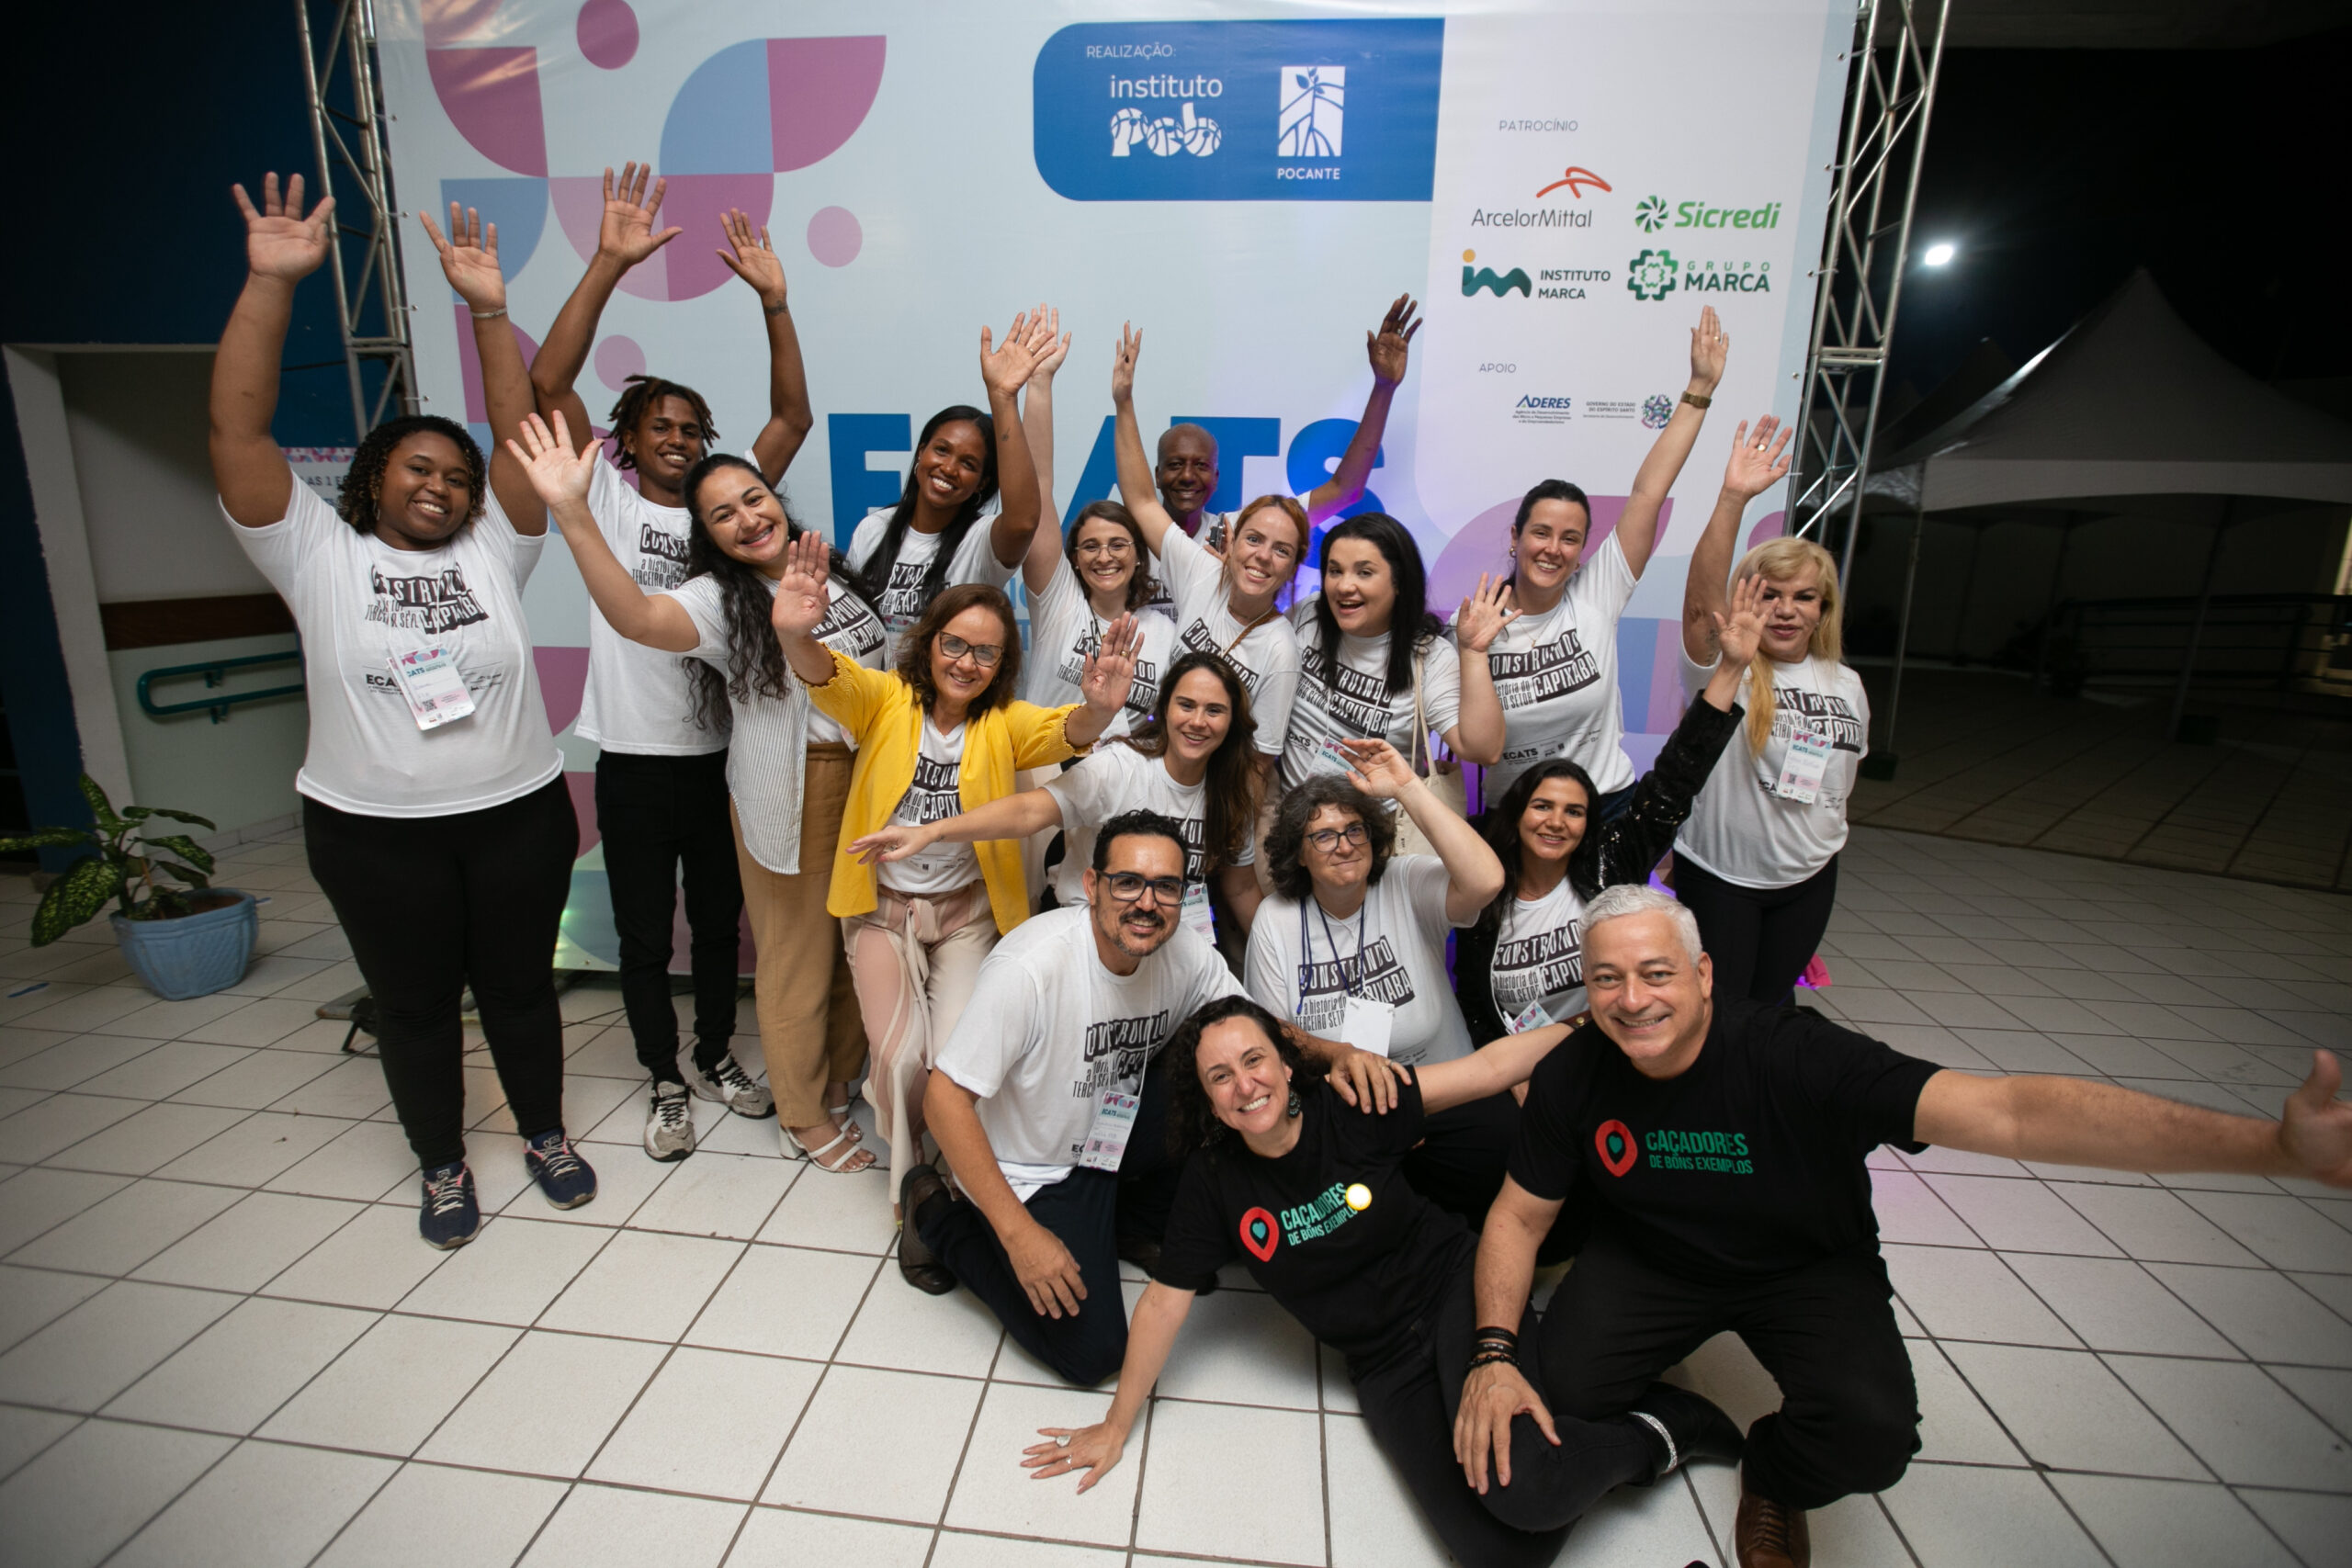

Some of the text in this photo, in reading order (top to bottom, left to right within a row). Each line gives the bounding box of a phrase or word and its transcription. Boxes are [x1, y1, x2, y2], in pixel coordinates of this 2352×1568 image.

[1086, 41, 1177, 61] REALIZAÇÃO:
[1110, 74, 1224, 98] instituto
[1498, 118, 1579, 132] PATROCÍNIO
[1276, 168, 1341, 181] POCANTE
[1471, 208, 1593, 228] ArcelorMittal
[1674, 201, 1782, 230] Sicredi
[1686, 261, 1770, 272] GRUPO
[1540, 269, 1611, 283] INSTITUTO
[1684, 273, 1770, 293] MARCA
[1538, 288, 1587, 299] MARCA
[1478, 363, 1517, 374] APOIO
[1516, 394, 1571, 409] ADERES
[1532, 653, 1598, 698] CAPIXABA
[1503, 748, 1539, 761] ECATS
[1645, 1130, 1749, 1157] CAÇADORES
[1649, 1154, 1665, 1169] DE
[1695, 1156, 1754, 1175] EXEMPLOS
[1280, 1182, 1348, 1232] CAÇADORES
[1287, 1232, 1302, 1247] DE
